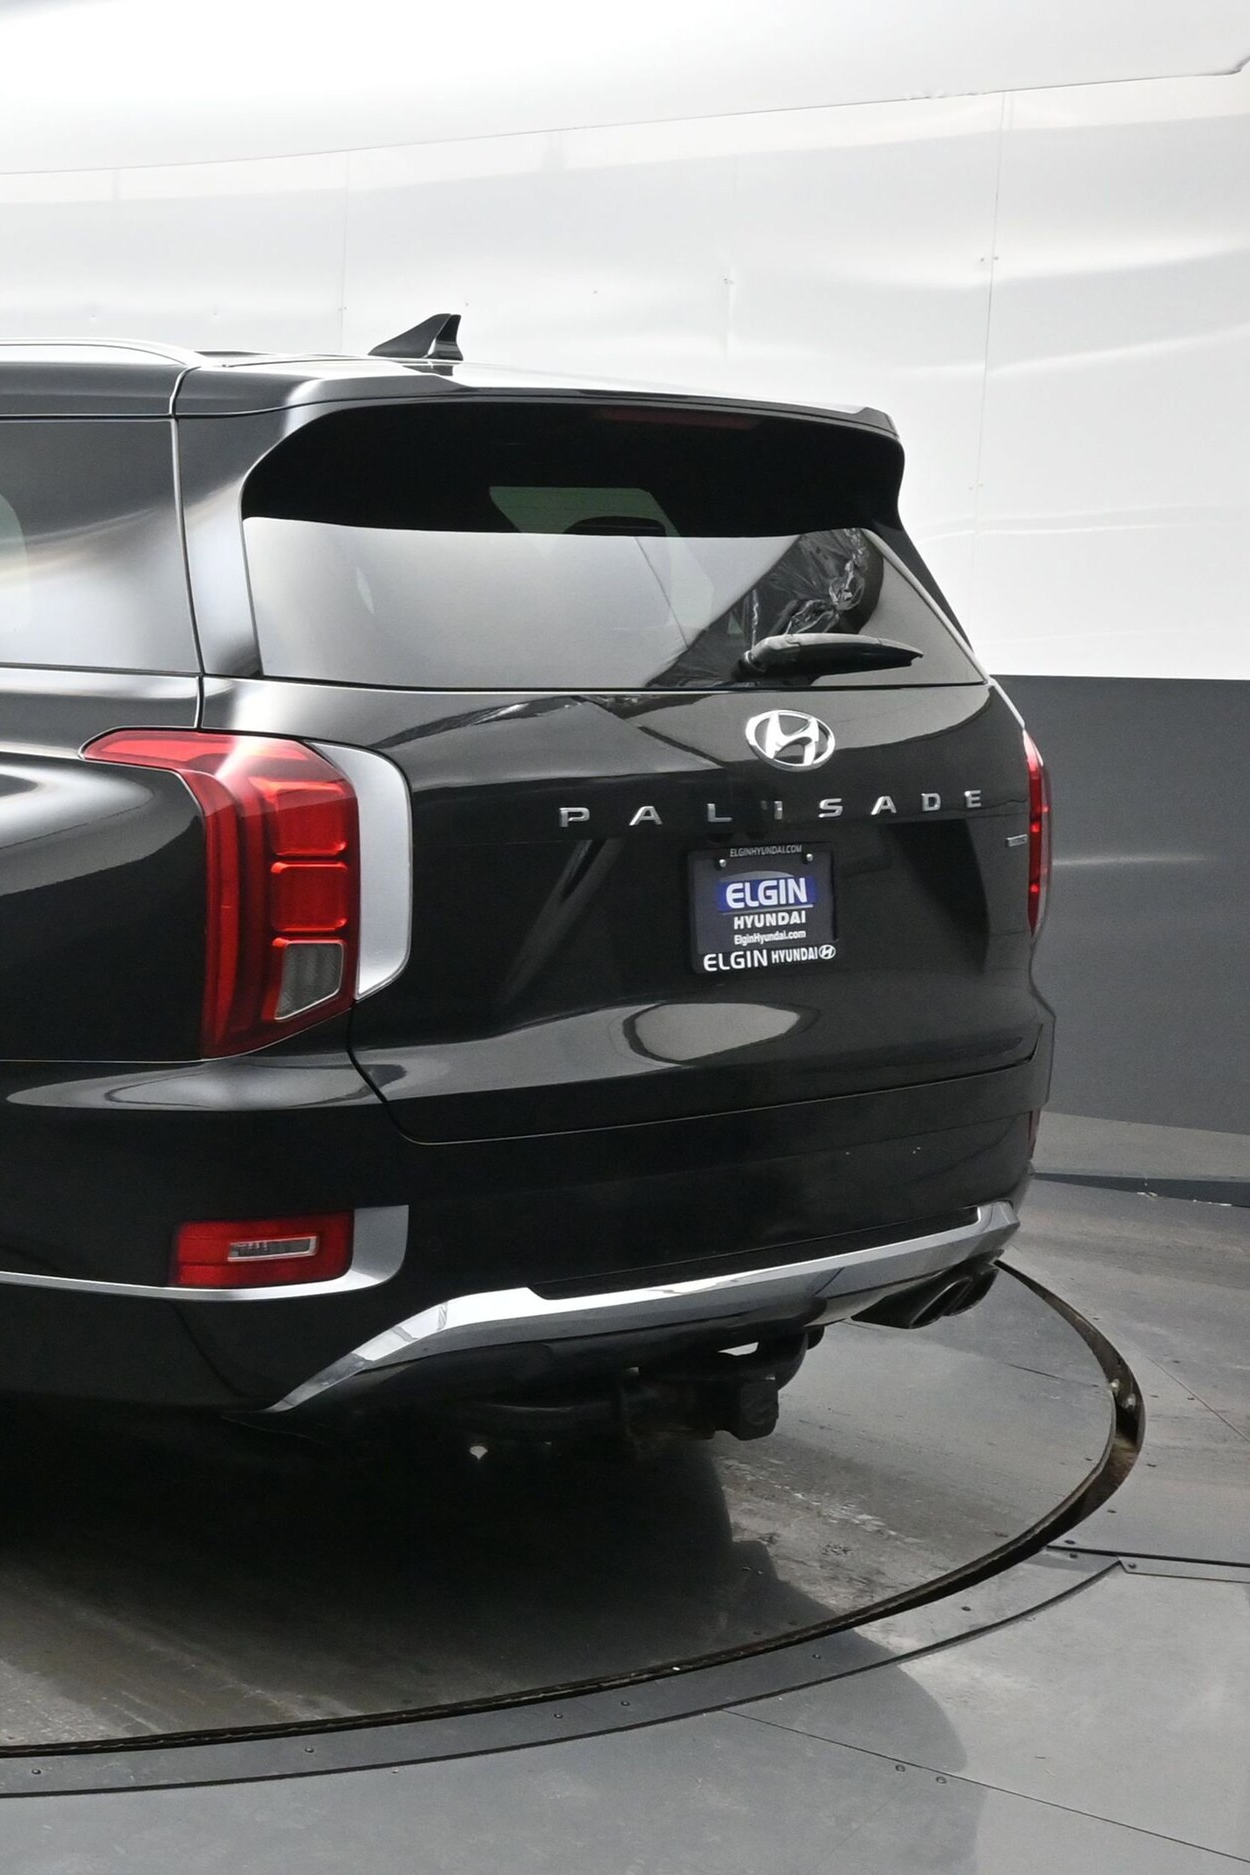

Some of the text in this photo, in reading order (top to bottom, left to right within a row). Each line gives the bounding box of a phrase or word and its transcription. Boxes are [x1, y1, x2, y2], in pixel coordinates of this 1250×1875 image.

[559, 790, 982, 828] PALISADE
[730, 844, 802, 857] ELGINHYUNDAI.COM
[725, 877, 808, 909] ELGIN
[733, 910, 806, 930] HYUNDAI
[734, 930, 806, 946] ElginHyundai.com
[703, 946, 818, 972] ELGIN HYUNDAI
